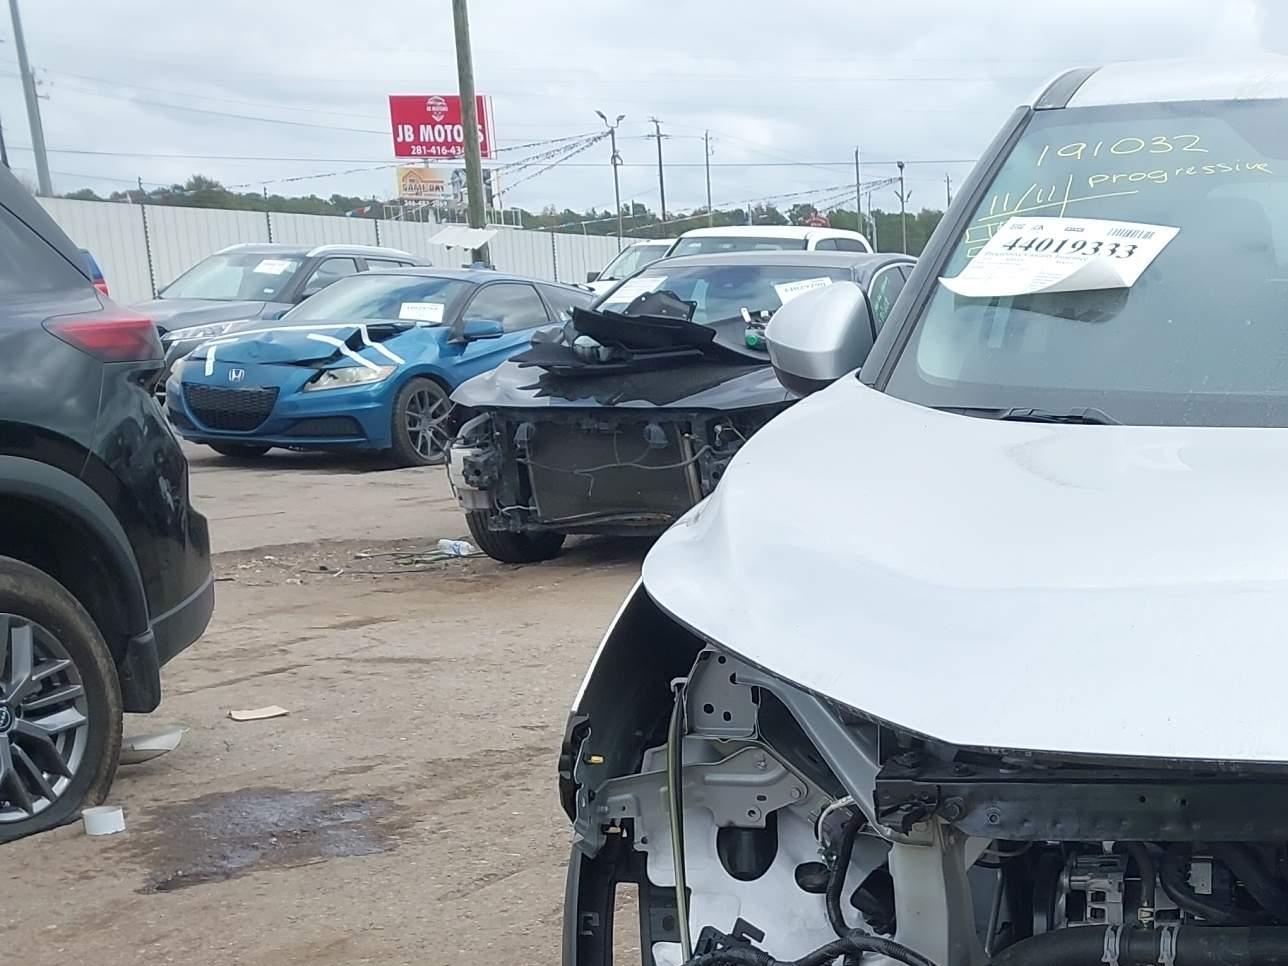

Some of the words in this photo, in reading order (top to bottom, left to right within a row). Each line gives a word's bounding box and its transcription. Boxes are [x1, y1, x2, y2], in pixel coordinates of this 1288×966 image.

[397, 124, 415, 143] JB
[420, 124, 484, 143] MOTOS
[1037, 134, 1209, 166] 191032
[1002, 236, 1139, 260] 44019333
